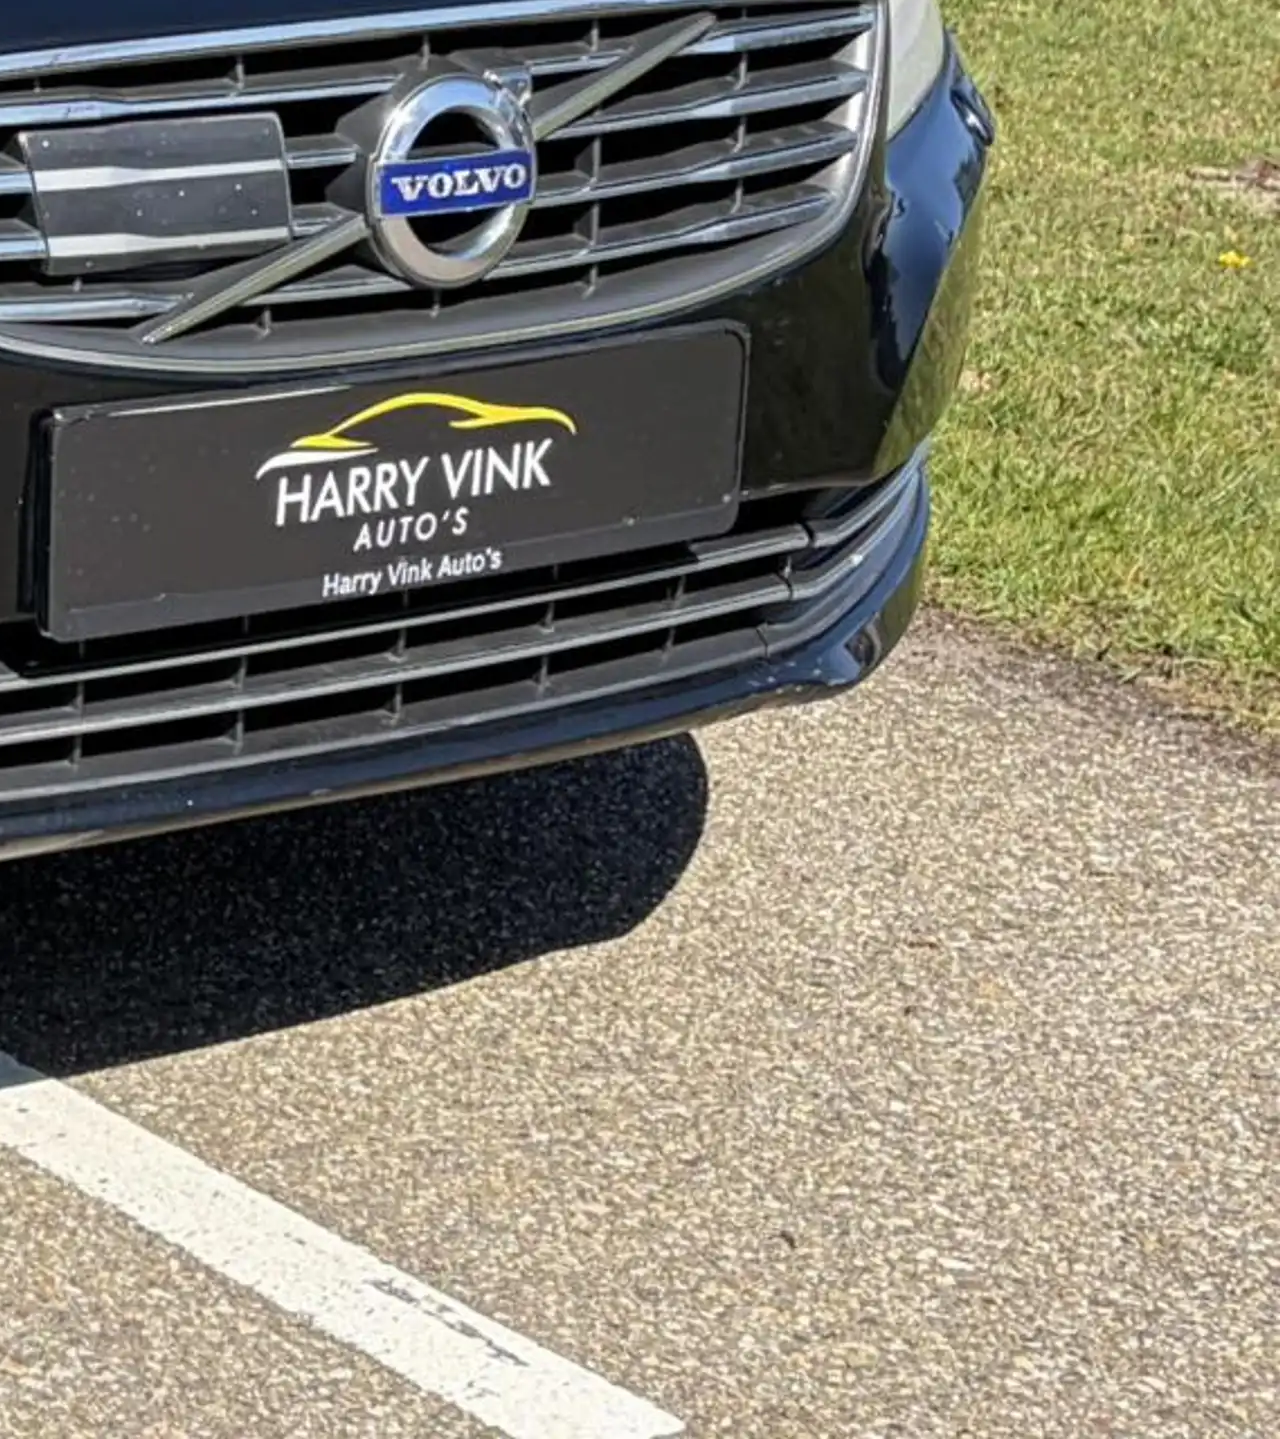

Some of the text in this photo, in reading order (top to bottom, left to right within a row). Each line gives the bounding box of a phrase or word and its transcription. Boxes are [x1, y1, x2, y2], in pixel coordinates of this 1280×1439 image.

[391, 163, 527, 202] VOLVO
[274, 437, 553, 528] HARRY VINK
[353, 507, 470, 553] AUTO'S
[322, 546, 503, 599] Harry Vink Auto's
